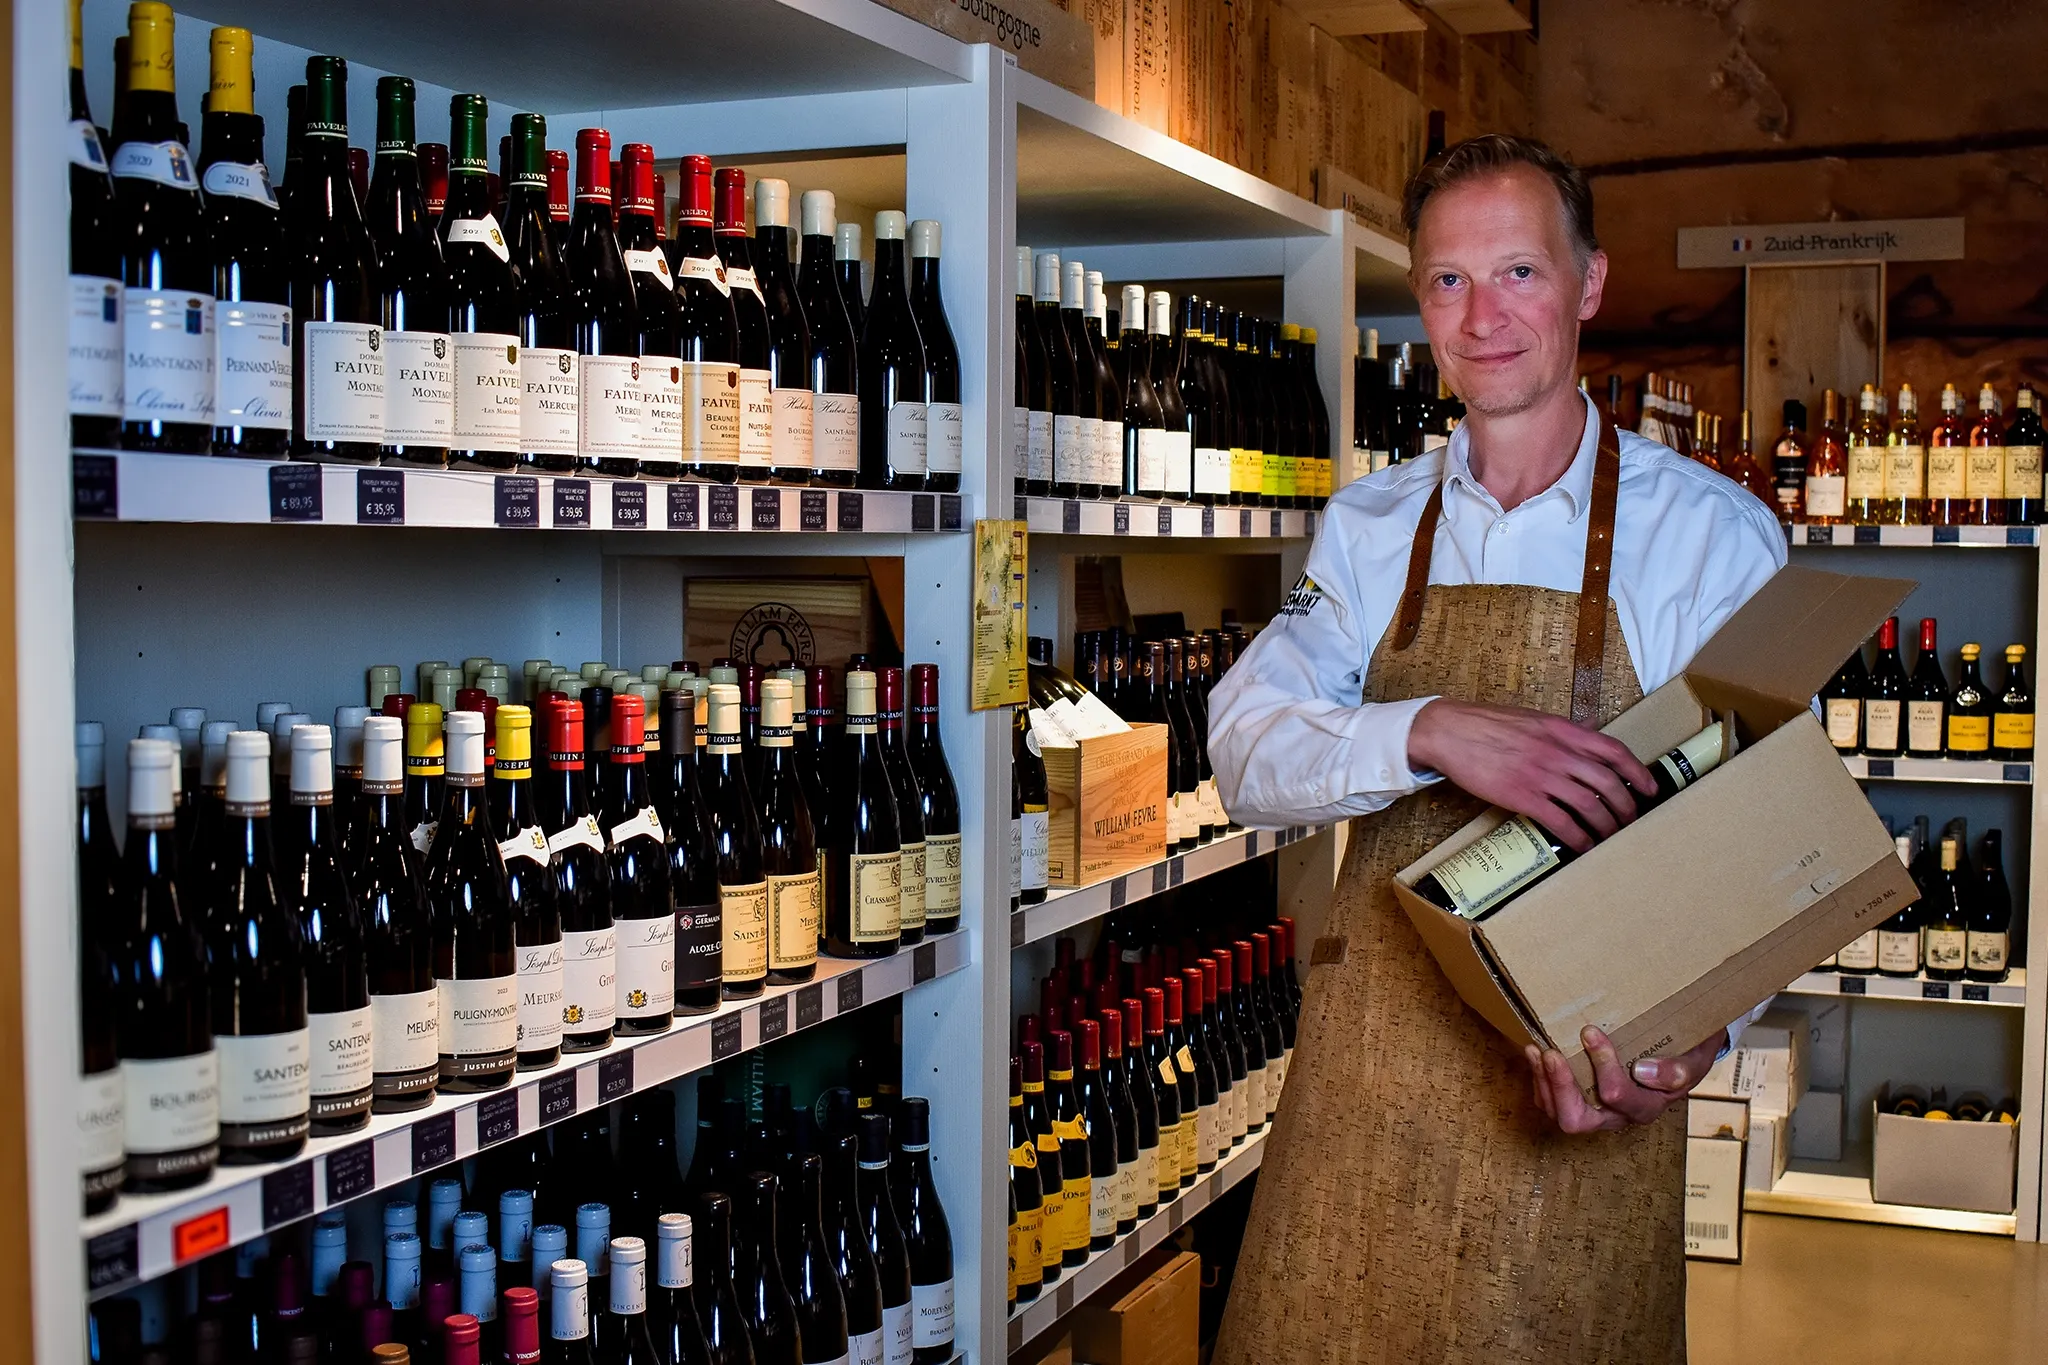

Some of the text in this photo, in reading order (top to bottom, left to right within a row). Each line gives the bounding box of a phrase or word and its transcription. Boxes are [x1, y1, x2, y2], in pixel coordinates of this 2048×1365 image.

[1133, 27, 1141, 116] POMEROL
[225, 174, 250, 187] 2021
[1764, 232, 1898, 254] Zuid-Frankrijk
[128, 351, 202, 372] MONTAGNY
[244, 396, 283, 419] Olivier
[733, 607, 782, 658] WILLIAM
[852, 715, 873, 725] LOUIS
[645, 732, 660, 741] OUIS
[713, 734, 736, 744] LOUIS
[611, 746, 629, 755] EPH
[1677, 758, 1693, 781] LOUIS
[1094, 812, 1131, 839] WILLIAM
[1132, 804, 1157, 829] FEVRE
[1128, 833, 1145, 845] FRANCE
[1468, 846, 1492, 873] GUETTES
[864, 893, 900, 905] CHASSAGNE
[1854, 911, 1860, 919] 6
[1866, 896, 1882, 911] 750
[1882, 888, 1897, 901] ML
[643, 924, 669, 945] Joseph
[580, 936, 608, 958] Joseph
[520, 949, 552, 972] Joseph
[338, 1051, 359, 1060] PREMIER
[1639, 1034, 1674, 1060] FRANCE
[463, 1060, 496, 1074] JUSTIN
[398, 1075, 428, 1090] JUSTIN
[317, 1099, 353, 1114] JUSTIN
